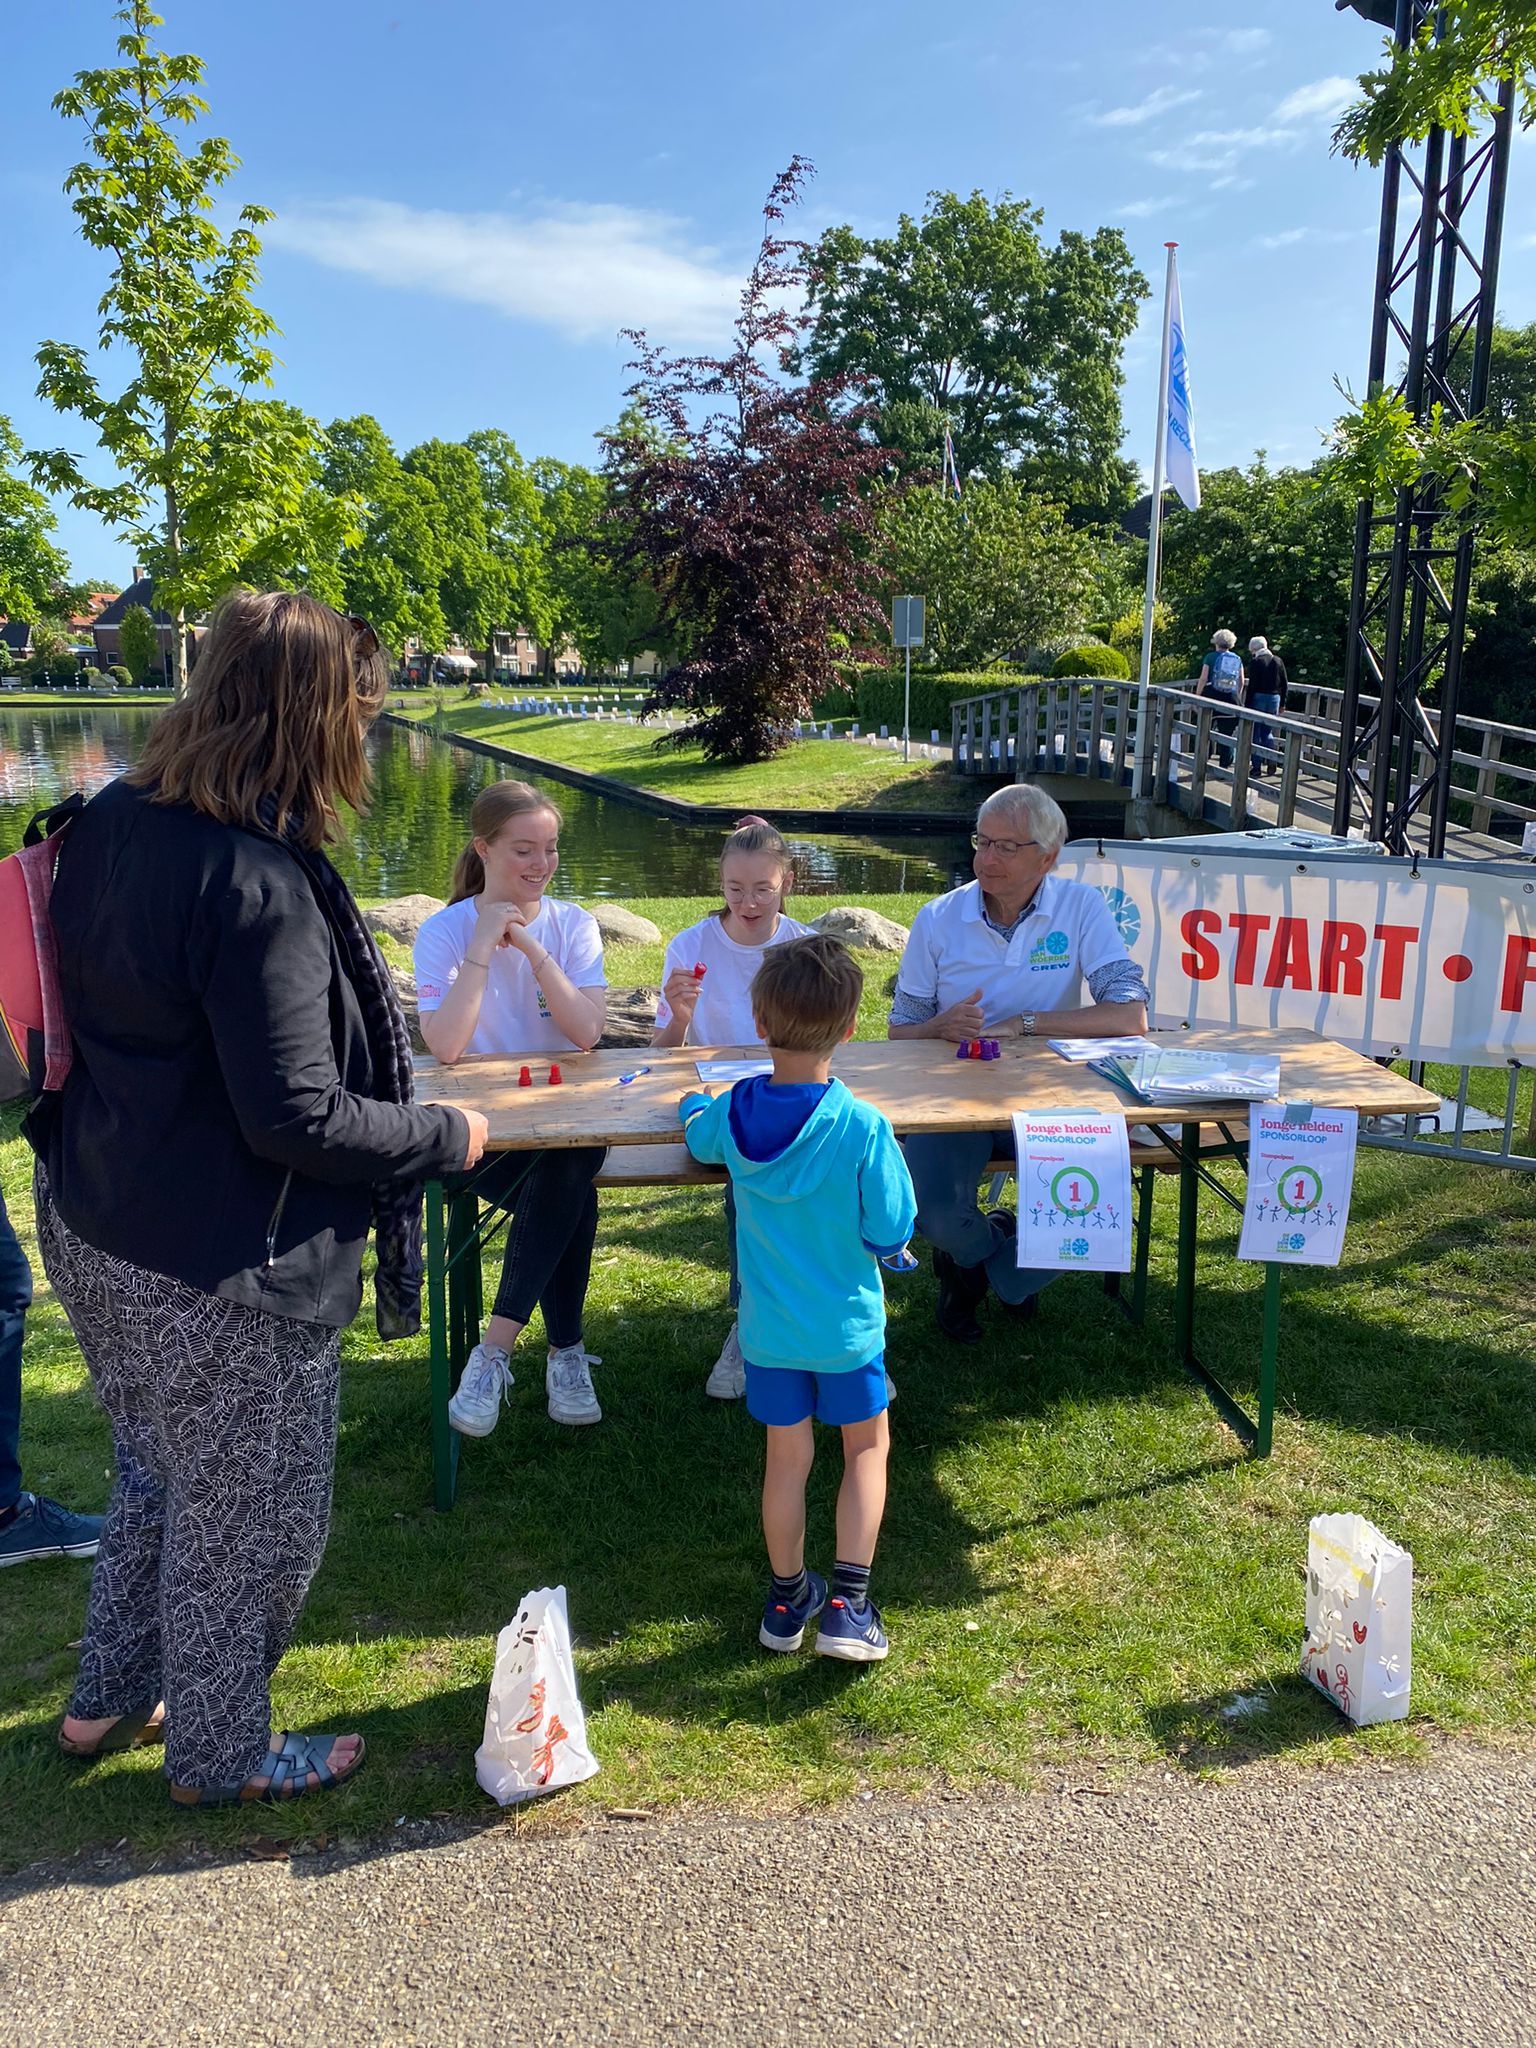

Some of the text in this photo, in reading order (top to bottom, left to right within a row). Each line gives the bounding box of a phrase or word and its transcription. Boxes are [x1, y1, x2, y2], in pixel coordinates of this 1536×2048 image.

[1180, 908, 1420, 1001] START
[1031, 962, 1070, 972] CREW
[1025, 1123, 1112, 1136] Jonge helden!
[1260, 1118, 1296, 1133] Jonge
[1026, 1134, 1097, 1145] SPONSORLOOP
[1260, 1130, 1328, 1144] SPONSORLOOP
[1069, 1181, 1082, 1203] 1
[1293, 1179, 1306, 1200] 1
